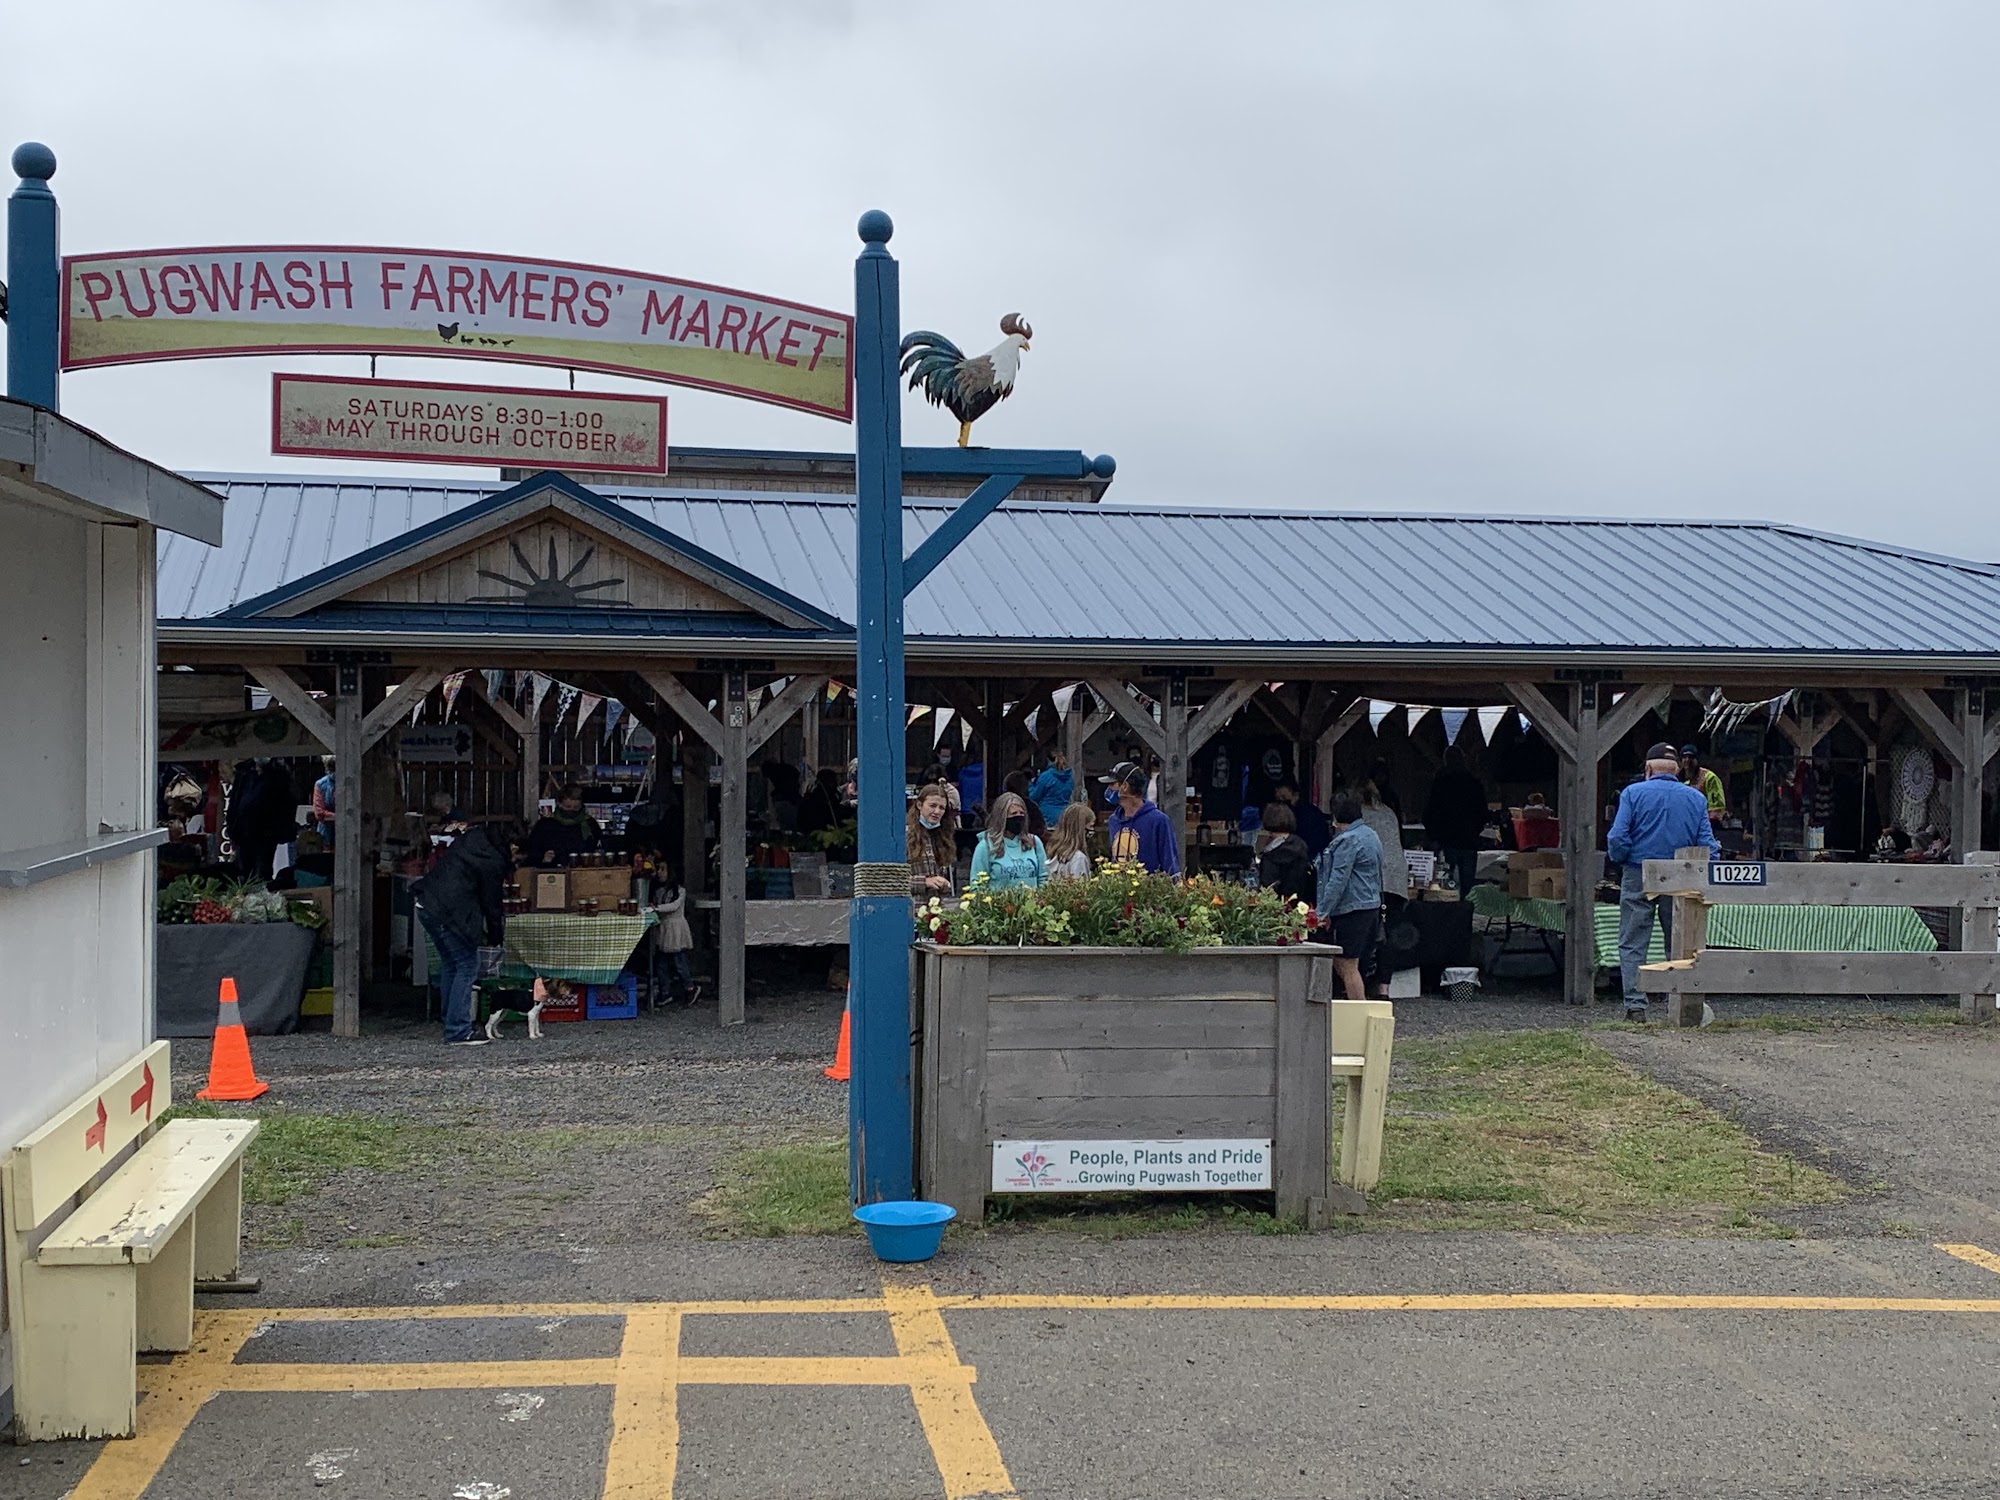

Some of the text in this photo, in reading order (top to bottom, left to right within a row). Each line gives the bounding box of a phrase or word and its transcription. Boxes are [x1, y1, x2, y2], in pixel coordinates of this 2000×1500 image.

[79, 259, 841, 373] PUGWASH FARMERS' MARKET
[347, 397, 484, 422] SATURDAYS
[326, 418, 617, 453] MAY THROUGH OCTOBER
[1716, 866, 1760, 881] 10222
[1070, 1149, 1263, 1168] People, Plants and Pride
[1139, 1170, 1200, 1186] Pugwash
[1205, 1170, 1263, 1186] Together
